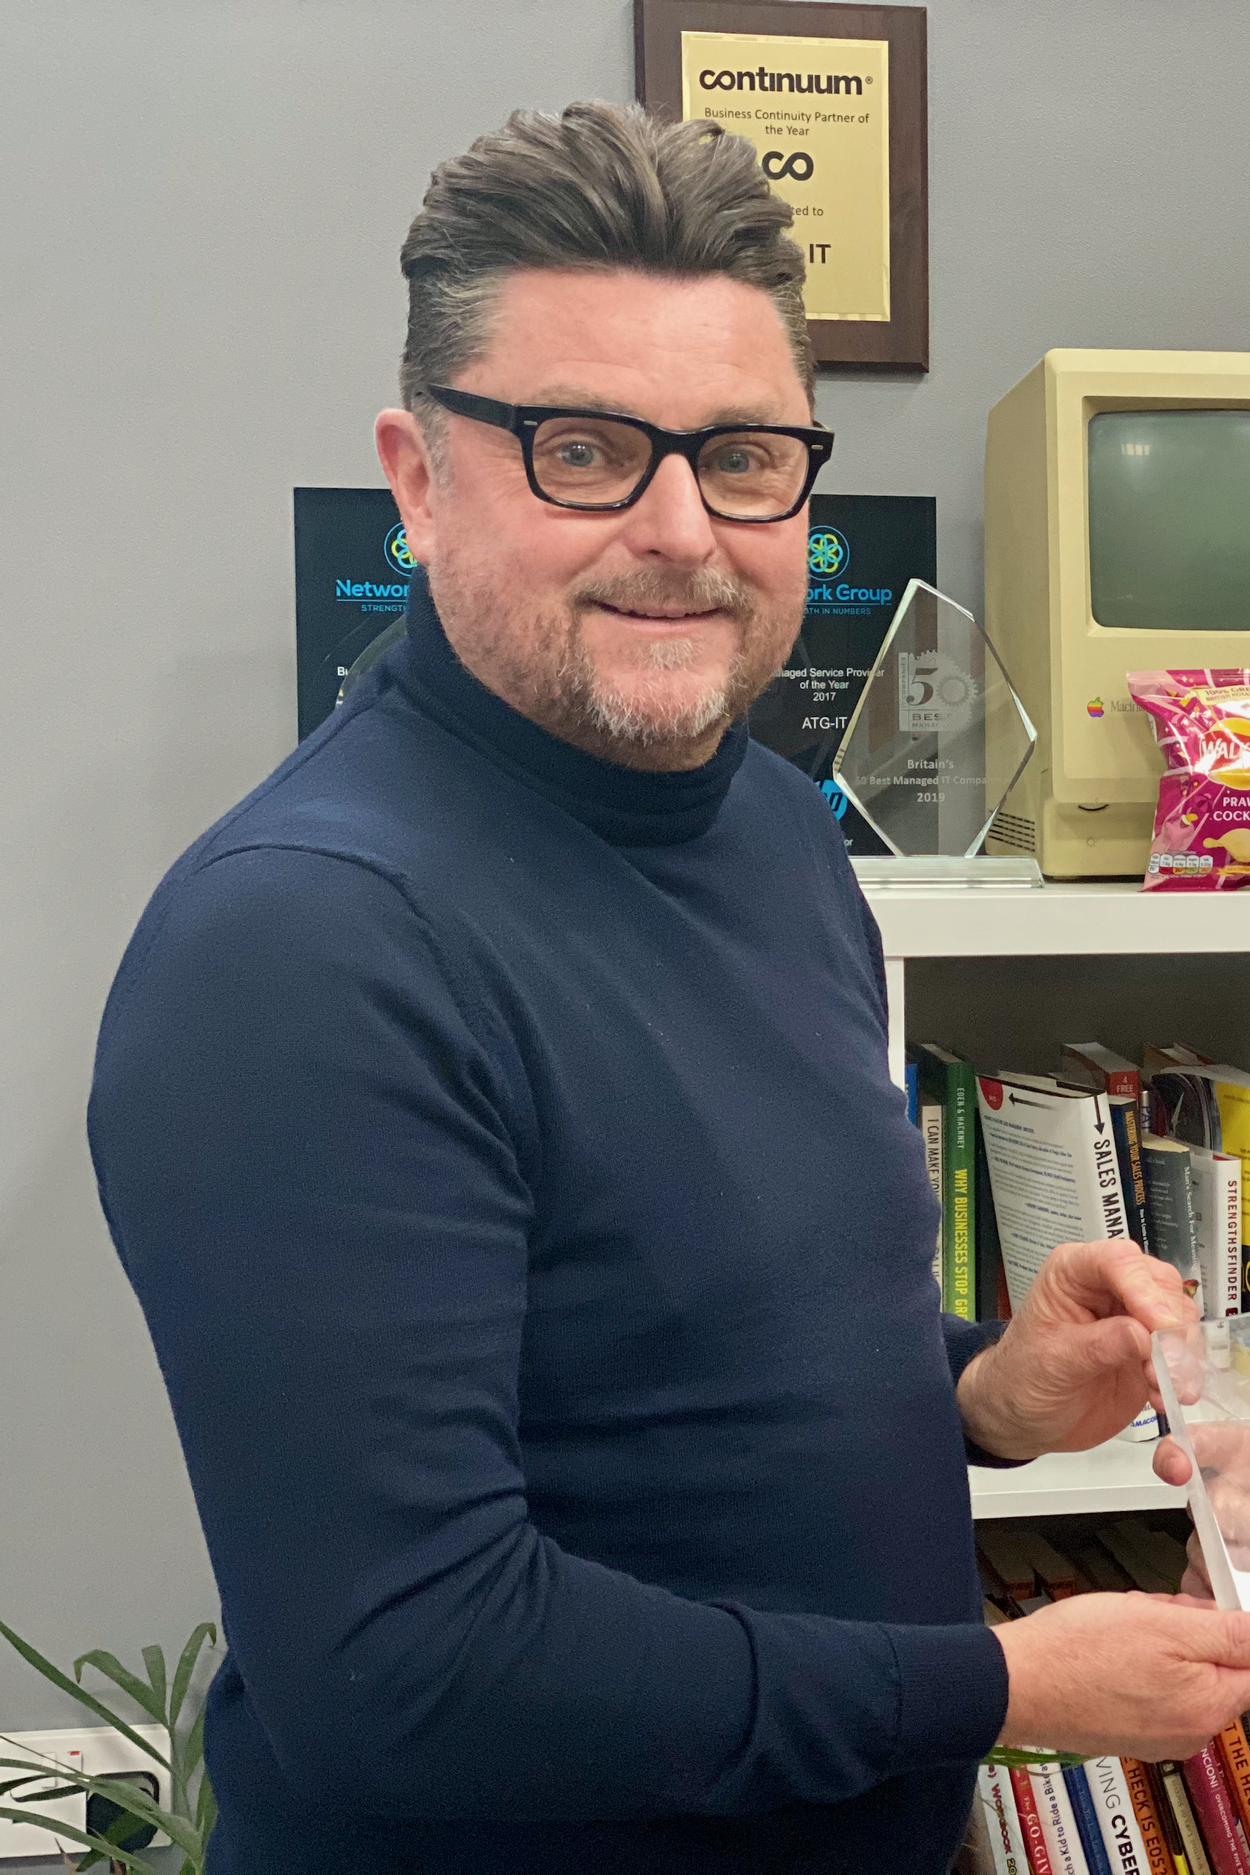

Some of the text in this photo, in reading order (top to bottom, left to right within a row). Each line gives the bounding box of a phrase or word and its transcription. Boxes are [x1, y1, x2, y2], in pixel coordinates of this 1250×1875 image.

[704, 107, 870, 124] Business Continuity Partner of
[765, 125, 810, 136] the Year
[812, 206, 824, 216] to
[808, 243, 832, 264] IT
[336, 579, 410, 597] Networ
[836, 584, 892, 605] Group
[809, 668, 844, 677] Service
[800, 680, 849, 689] of the Year
[812, 692, 837, 701] 2017
[802, 716, 848, 730] ATG-IT
[907, 759, 954, 770] Britain's
[869, 776, 892, 785] Best
[893, 776, 939, 787] Managed
[941, 776, 950, 785] IT
[917, 792, 946, 802] 2019
[1116, 1084, 1134, 1093] FREE
[1122, 1075, 1128, 1083] 4
[957, 1087, 965, 1106] EDEN
[928, 1128, 939, 1145] CAN
[957, 1116, 965, 1149] HACKNEY
[1125, 1111, 1137, 1145] MASTERING
[928, 1147, 940, 1171] MAKE
[1130, 1146, 1140, 1162] YOUR
[1132, 1162, 1142, 1179] SALES
[955, 1169, 968, 1194] WHY
[1094, 1139, 1125, 1240] SALES MANA
[1134, 1180, 1146, 1206] PROCESS
[1186, 1191, 1195, 1218] Search
[955, 1197, 968, 1264] BUSINESSES
[1227, 1180, 1238, 1301] STRENGTHSFINDER
[1189, 1235, 1198, 1272] Meaning
[955, 1266, 968, 1295] STOP
[1229, 1736, 1249, 1771] THE
[1127, 1767, 1152, 1813] HECK
[1141, 1814, 1155, 1832] IS
[1200, 1747, 1219, 1789] NCIONI
[1214, 1793, 1233, 1839] OVERCOMING
[1227, 1837, 1237, 1852] THE
[1233, 1852, 1243, 1868] FIVE
[1050, 1803, 1062, 1827] Ride
[1057, 1827, 1066, 1838] to
[1026, 1813, 1051, 1875] GO-GIV
[1058, 1839, 1070, 1857] Kid
